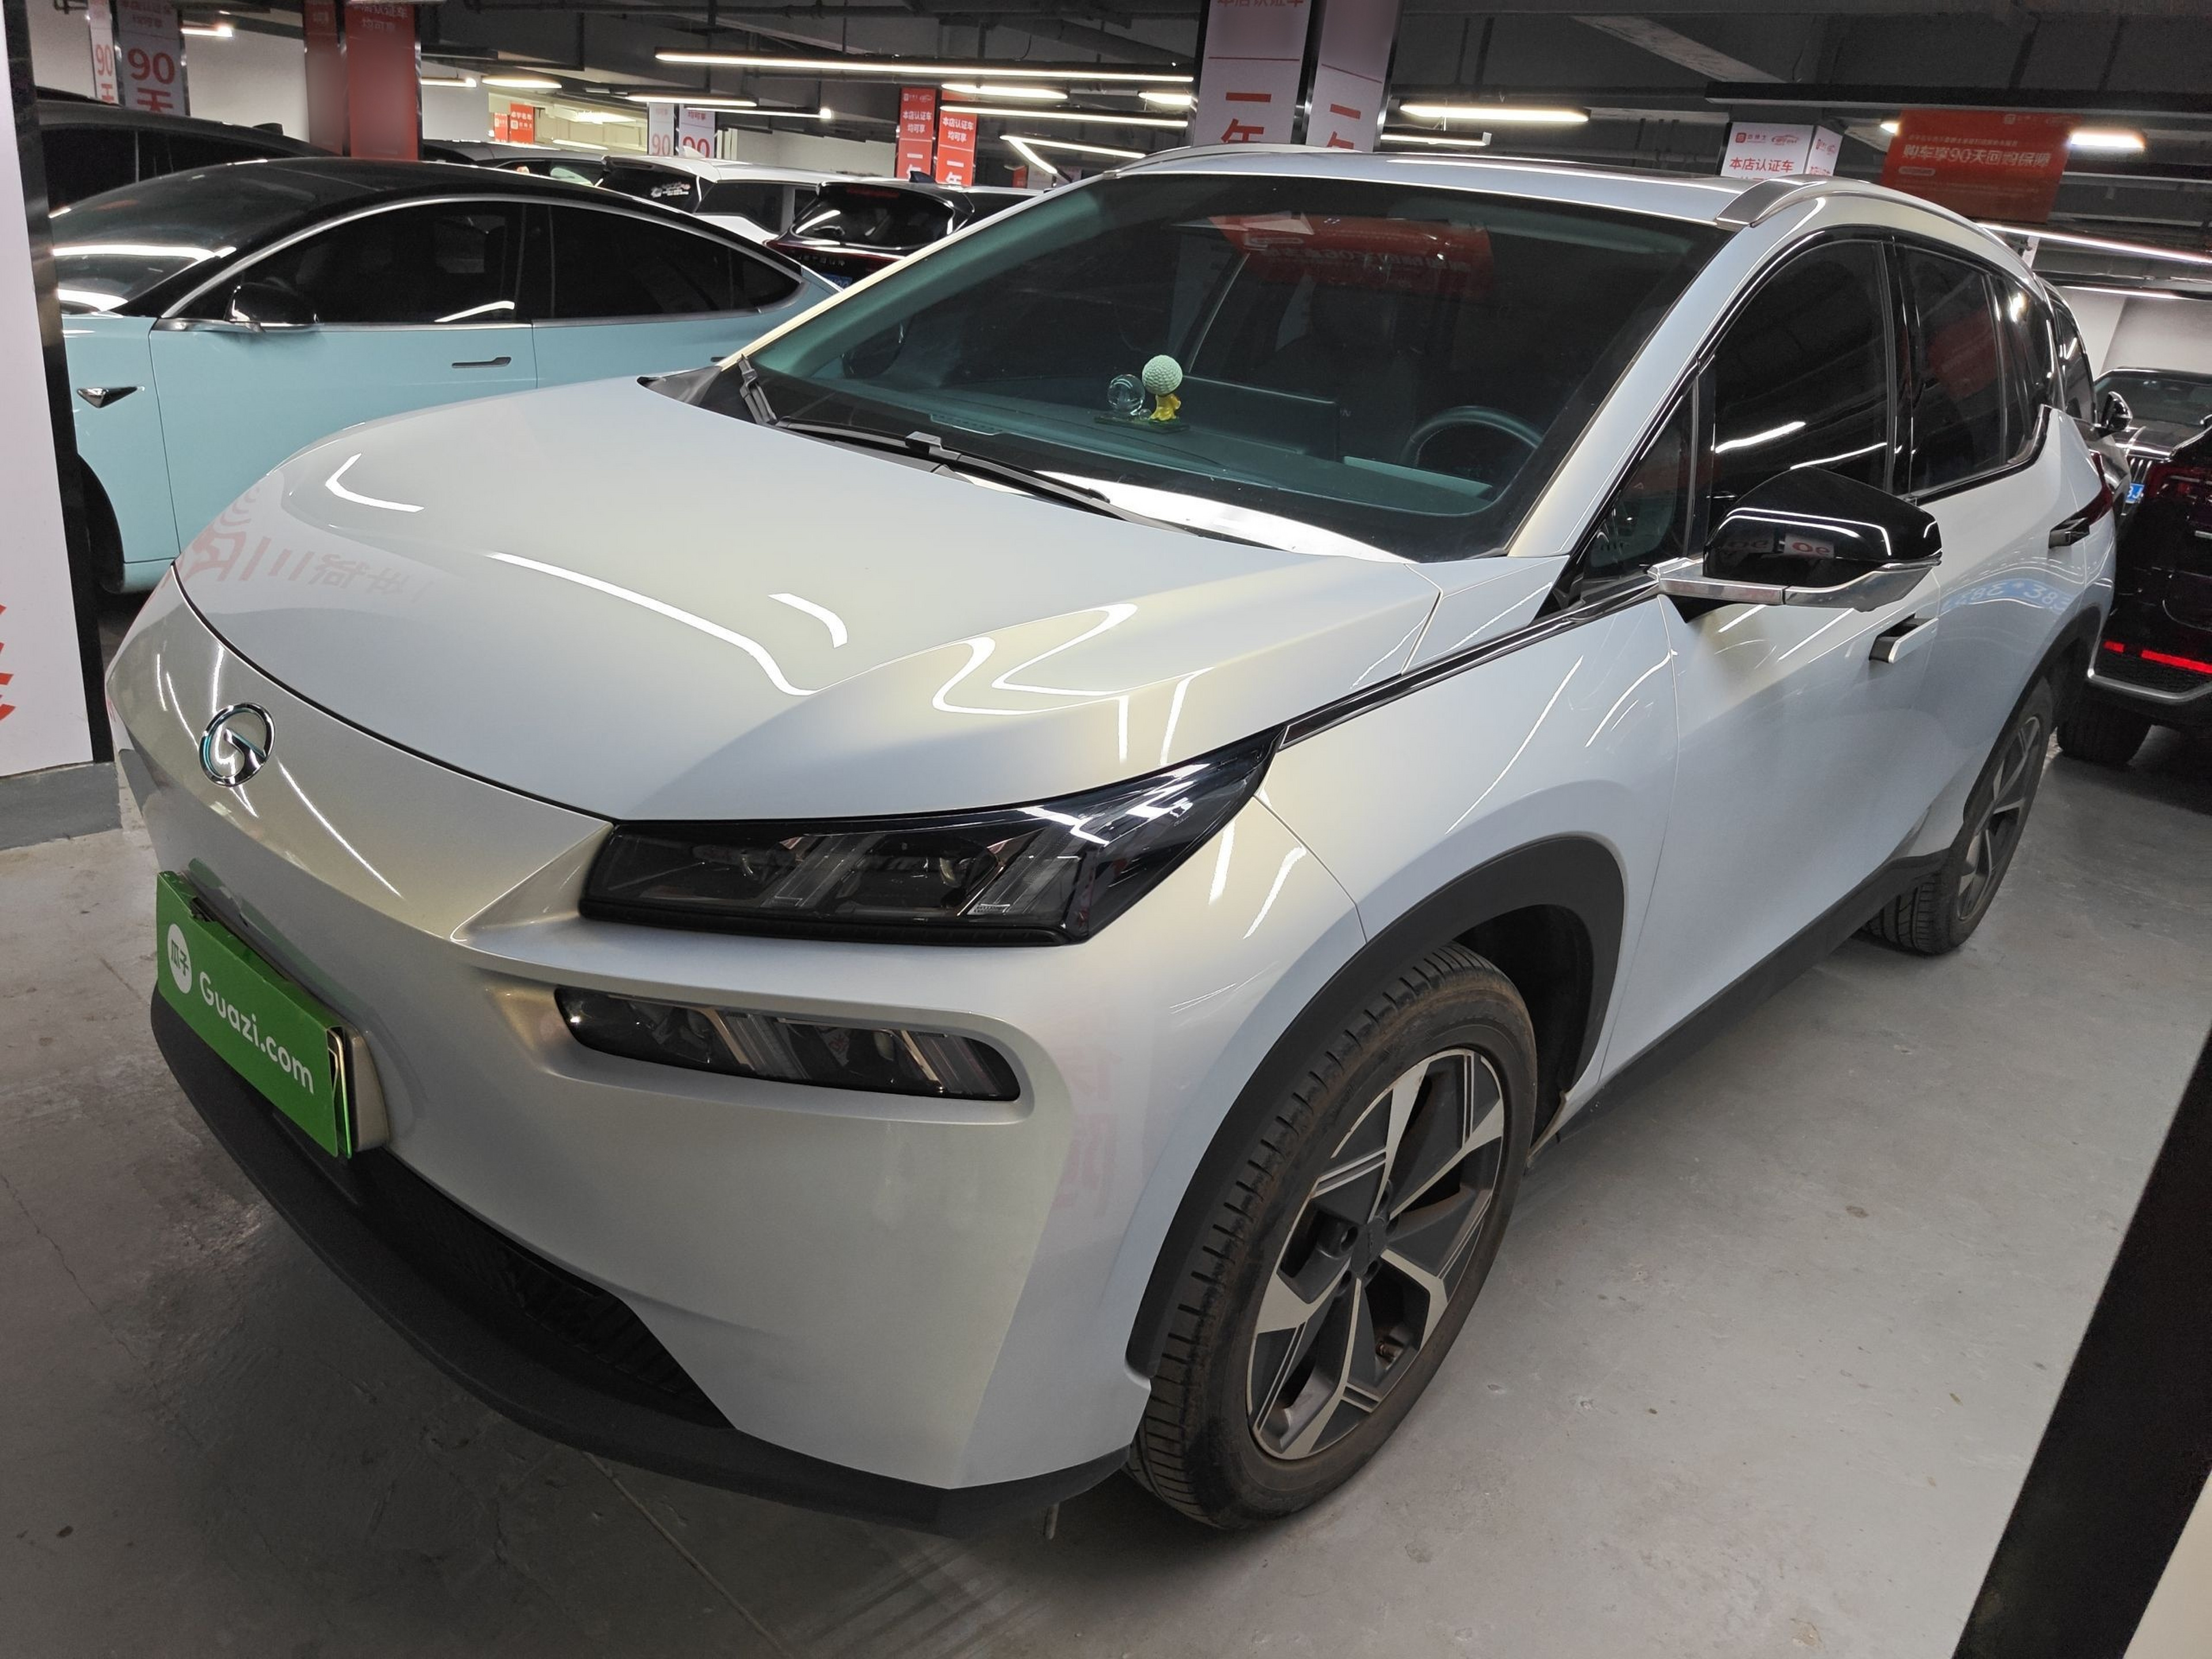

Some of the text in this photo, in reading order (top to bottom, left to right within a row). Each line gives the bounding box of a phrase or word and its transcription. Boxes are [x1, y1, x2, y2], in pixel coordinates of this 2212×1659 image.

[95, 44, 113, 77] 90
[127, 48, 175, 85] 90
[903, 111, 932, 121] 本店认证车
[942, 117, 974, 130] 本店认证车
[1729, 157, 1795, 173] 本店认证车
[171, 940, 189, 976] 瓜子
[200, 971, 314, 1094] Guazi.com
